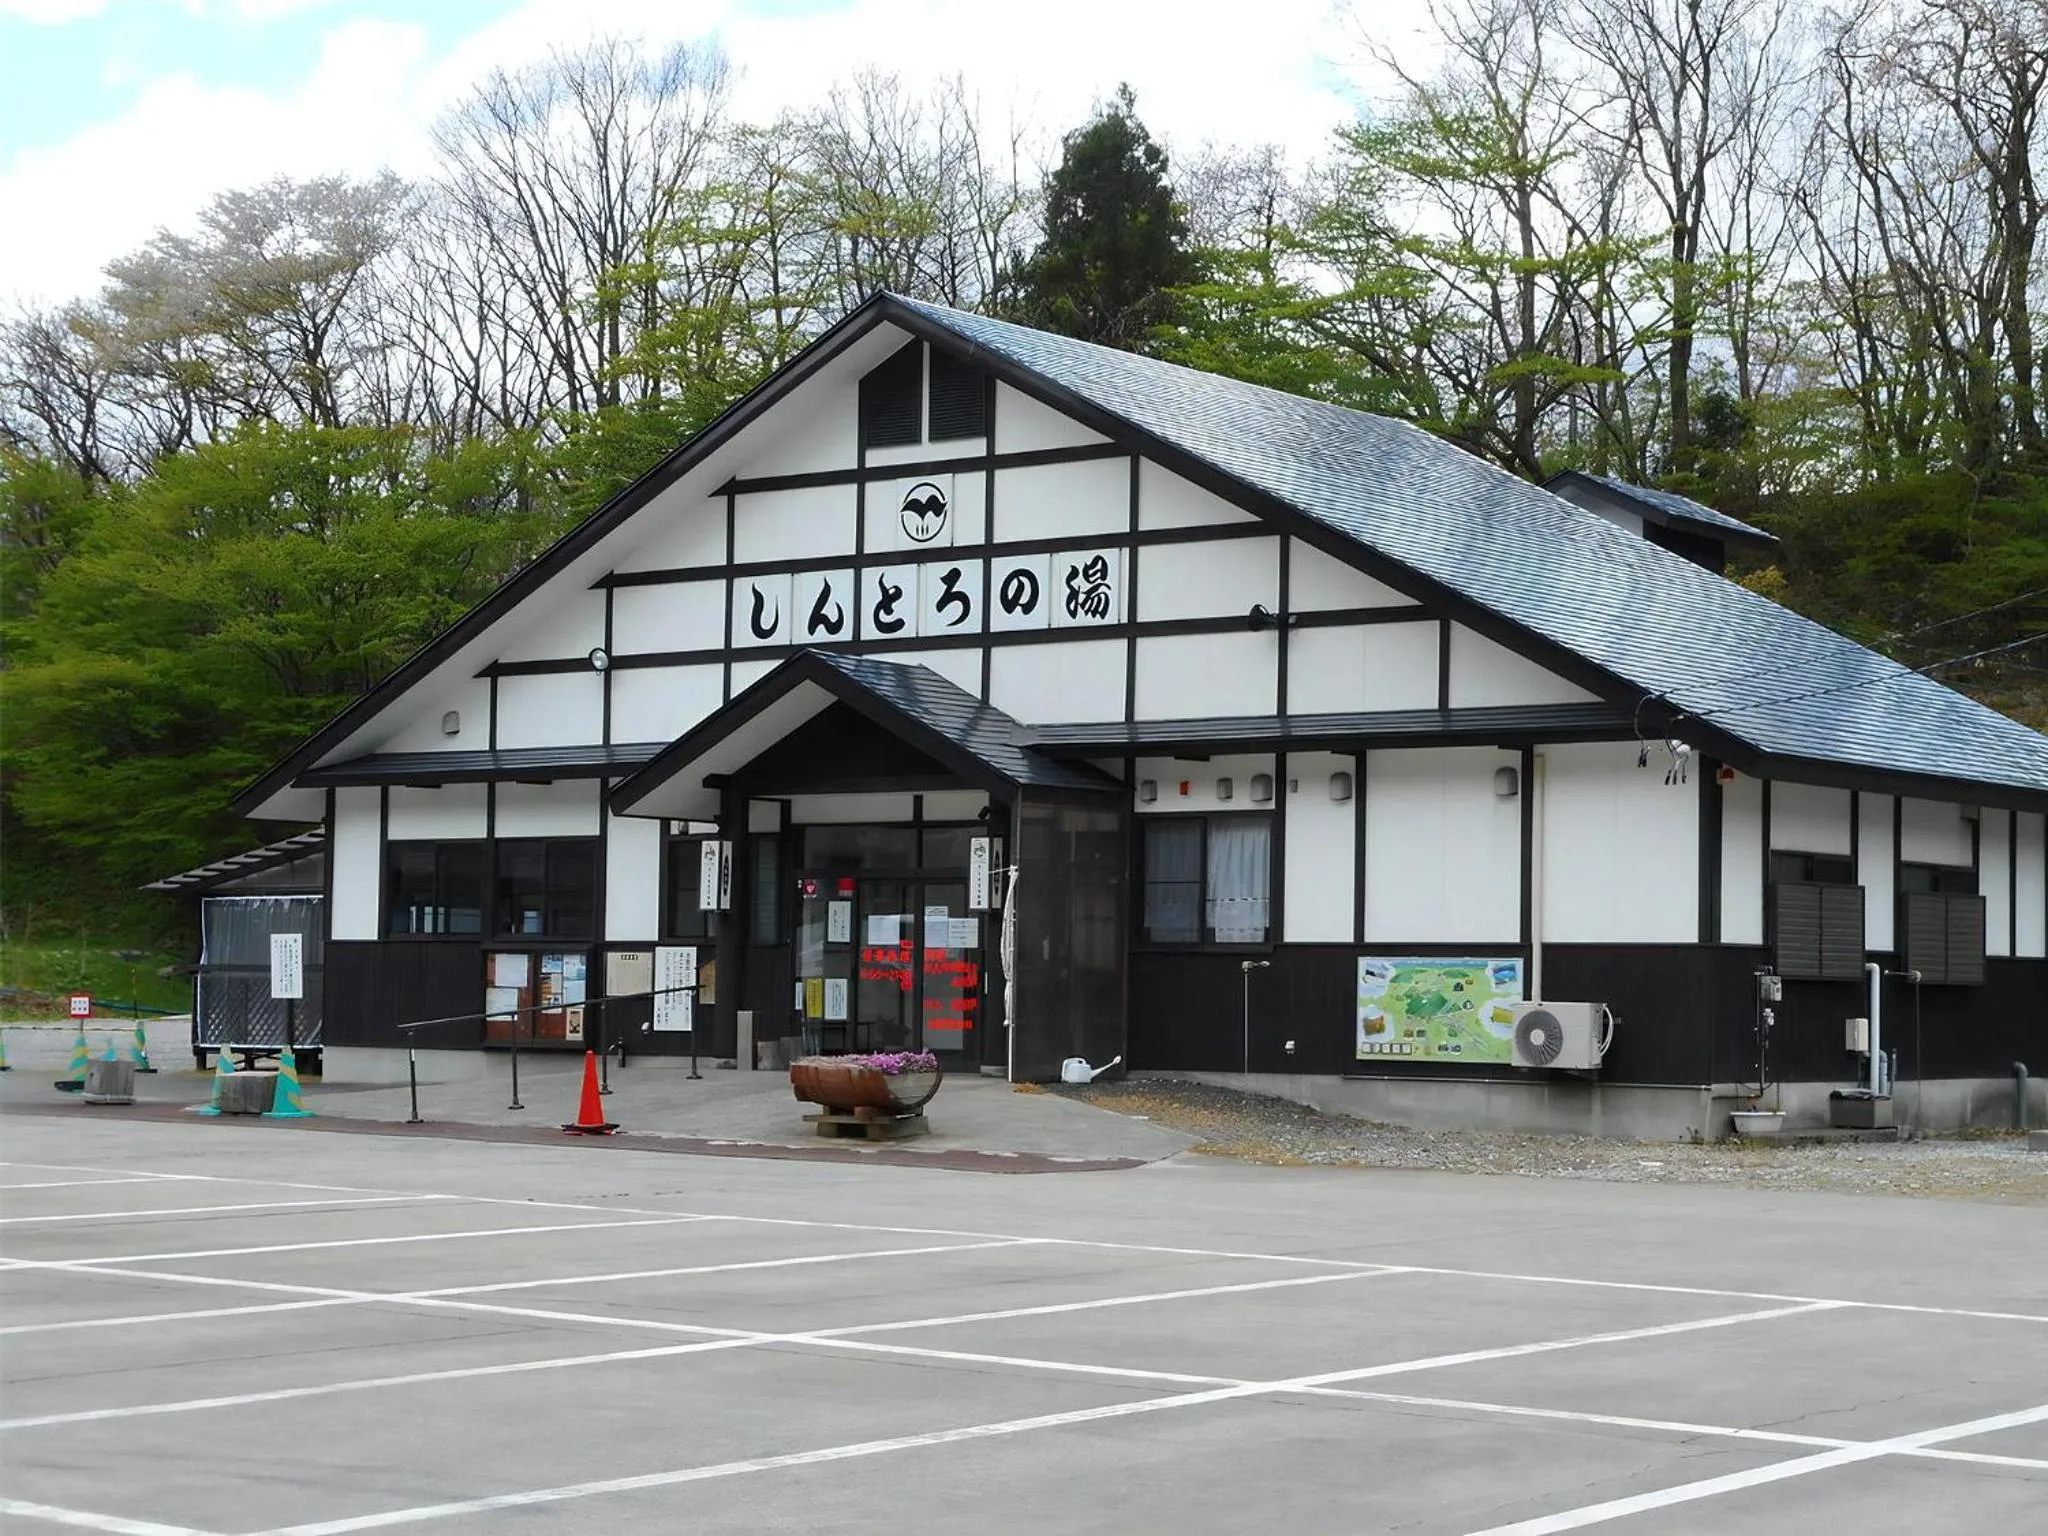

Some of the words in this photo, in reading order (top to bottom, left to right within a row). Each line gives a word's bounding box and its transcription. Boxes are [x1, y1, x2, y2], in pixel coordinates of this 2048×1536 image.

[751, 555, 1111, 639] しんとろの湯
